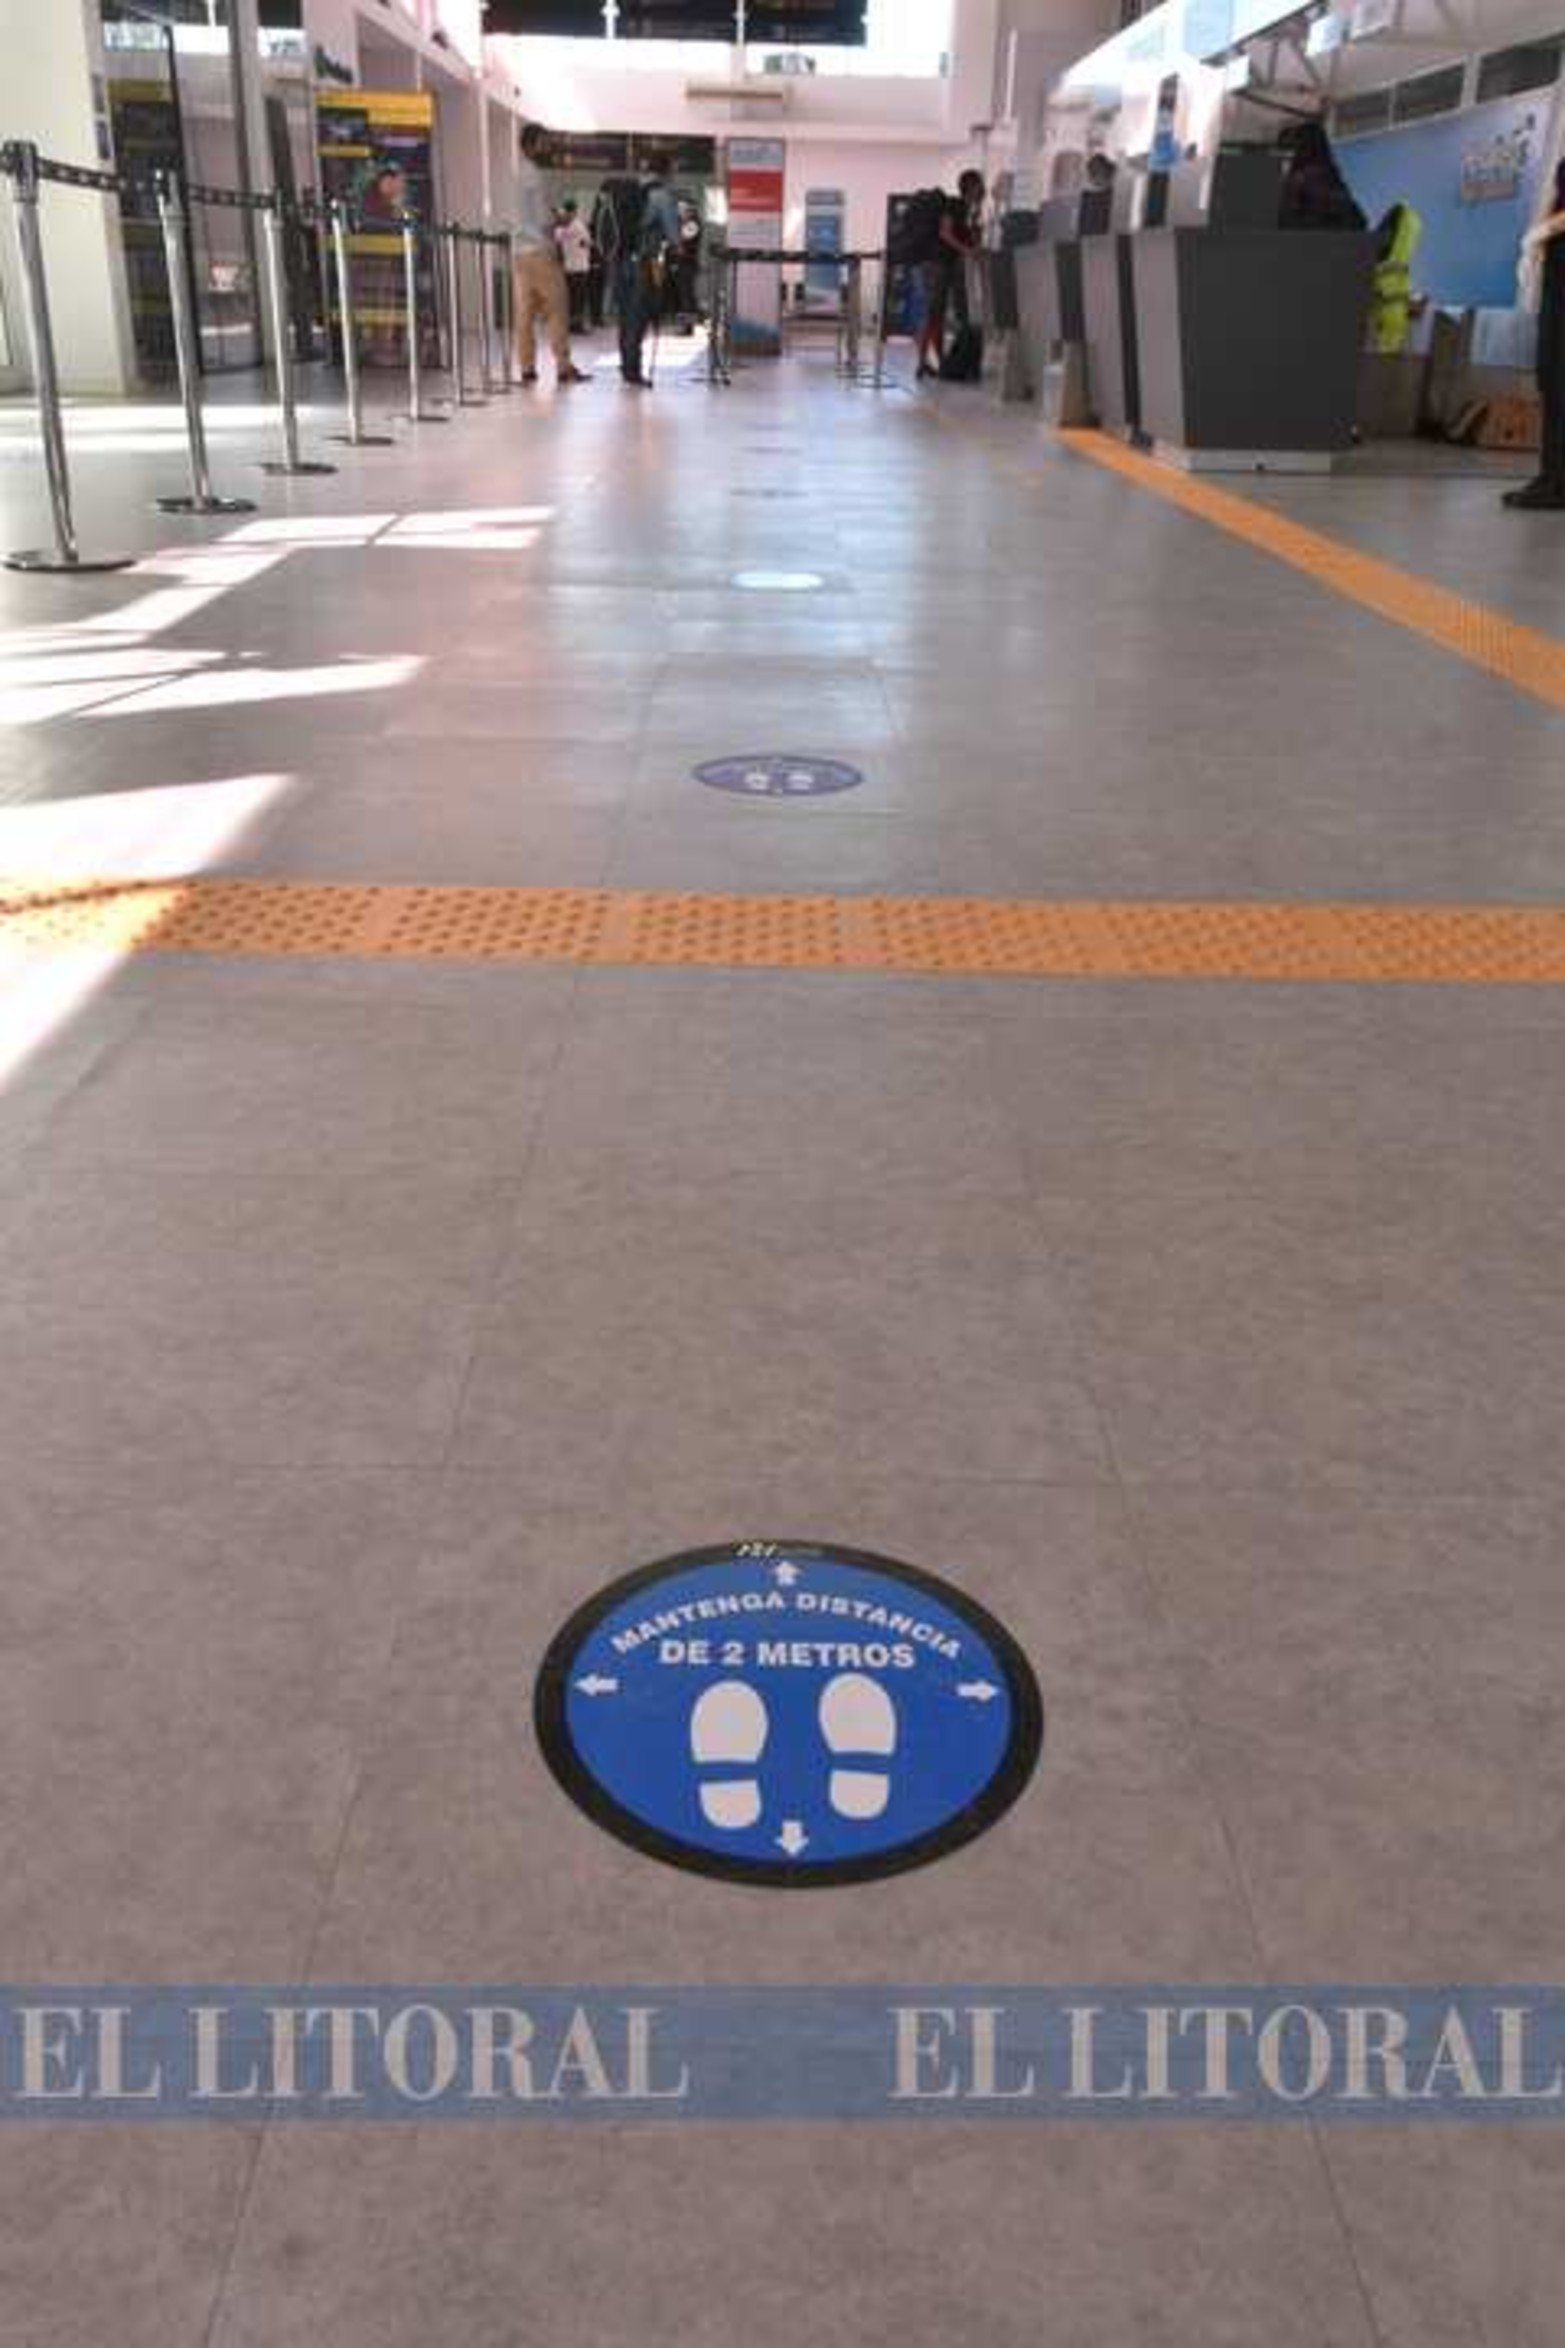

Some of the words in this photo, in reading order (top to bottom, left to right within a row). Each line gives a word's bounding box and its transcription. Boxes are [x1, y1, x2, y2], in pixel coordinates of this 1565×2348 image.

[610, 1591, 785, 1654] MANTENGA
[796, 1592, 962, 1659] DISTANCIA
[659, 1639, 710, 1665] DE
[720, 1640, 745, 1667] 2
[757, 1642, 915, 1669] METROS
